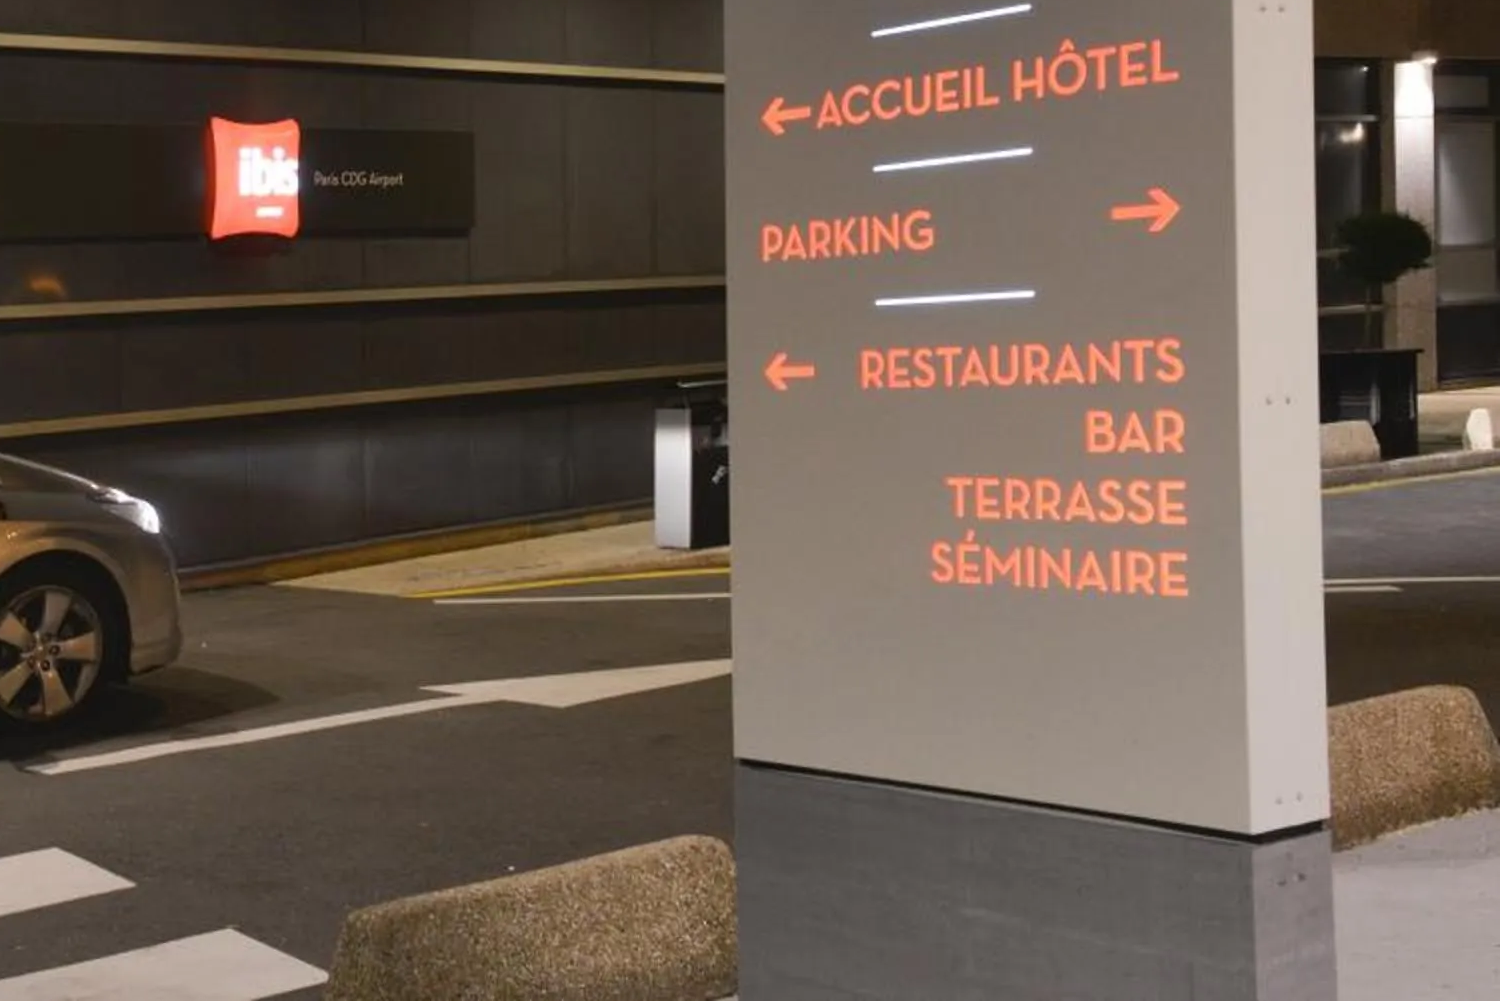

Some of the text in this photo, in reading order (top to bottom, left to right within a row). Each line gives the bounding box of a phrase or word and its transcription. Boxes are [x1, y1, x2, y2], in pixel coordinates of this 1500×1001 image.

[815, 38, 1181, 130] ACCUEIL HÔTEL
[238, 146, 300, 198] ibis
[314, 170, 405, 189] Paris CDG Airport
[760, 208, 936, 263] PARKING
[857, 336, 1187, 391] RESTAURANTS
[1082, 406, 1187, 458] BAR
[944, 474, 1189, 527] TERRASSE
[929, 528, 1190, 599] SÉMINAIRE
